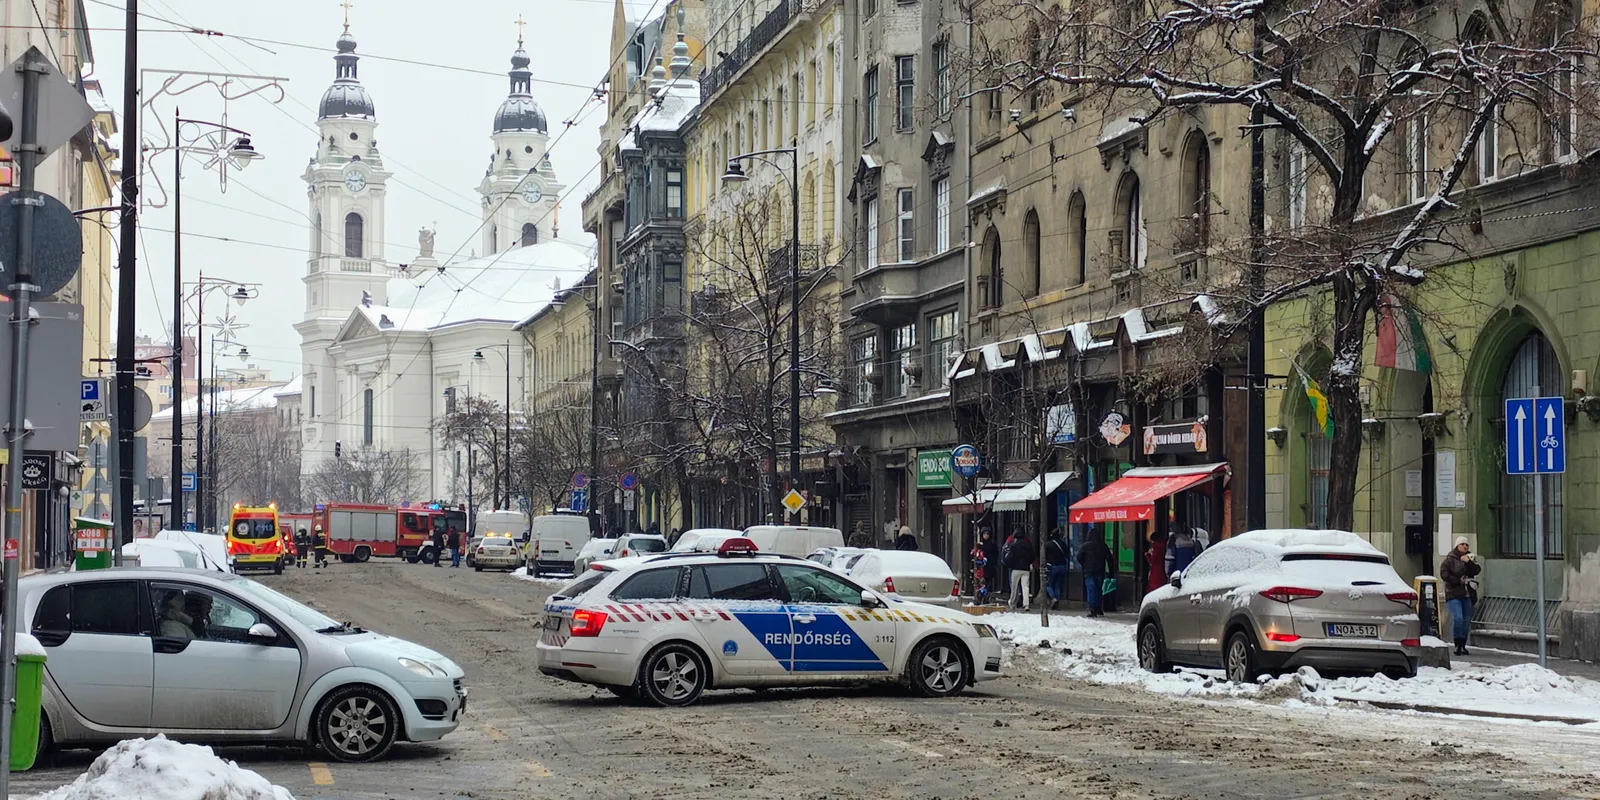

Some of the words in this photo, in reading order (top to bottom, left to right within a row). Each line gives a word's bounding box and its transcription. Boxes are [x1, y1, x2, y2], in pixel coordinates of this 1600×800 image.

[83, 383, 93, 398] P
[1336, 625, 1375, 635] NOA-512
[765, 631, 851, 645] RENDŐRSÉG
[881, 635, 895, 643] 112
